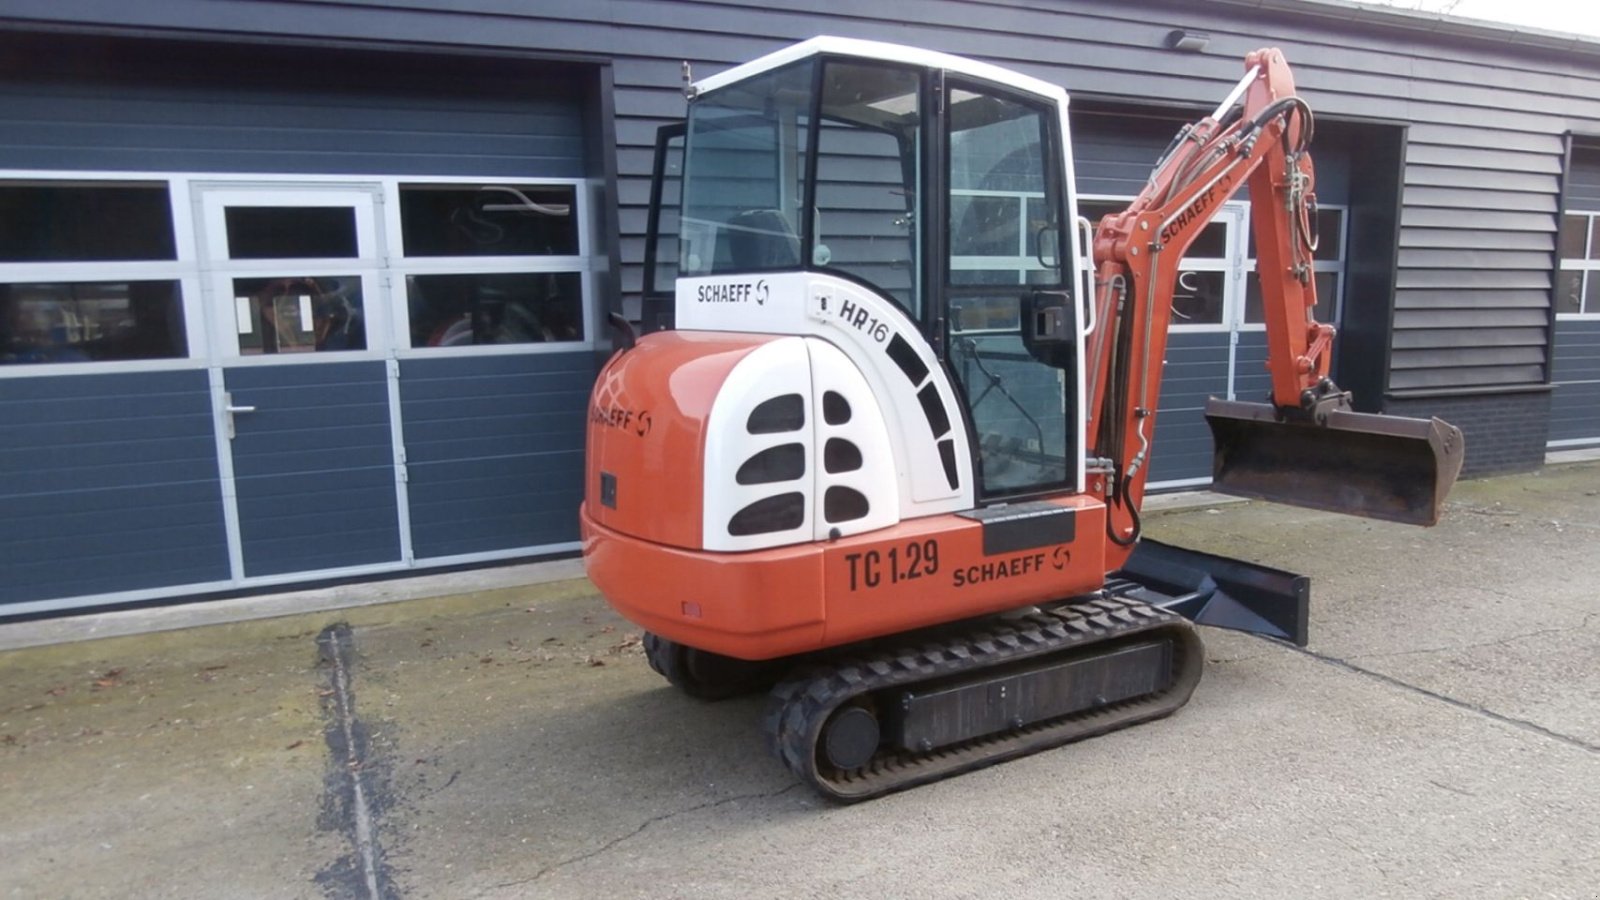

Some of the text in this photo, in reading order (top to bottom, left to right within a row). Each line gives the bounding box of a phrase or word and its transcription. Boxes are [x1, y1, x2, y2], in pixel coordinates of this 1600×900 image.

[1161, 186, 1215, 243] SCHAEFF
[698, 284, 752, 303] SCHAEFF
[845, 539, 939, 592] TC 1.29
[953, 553, 1045, 587] SCHAEFF
